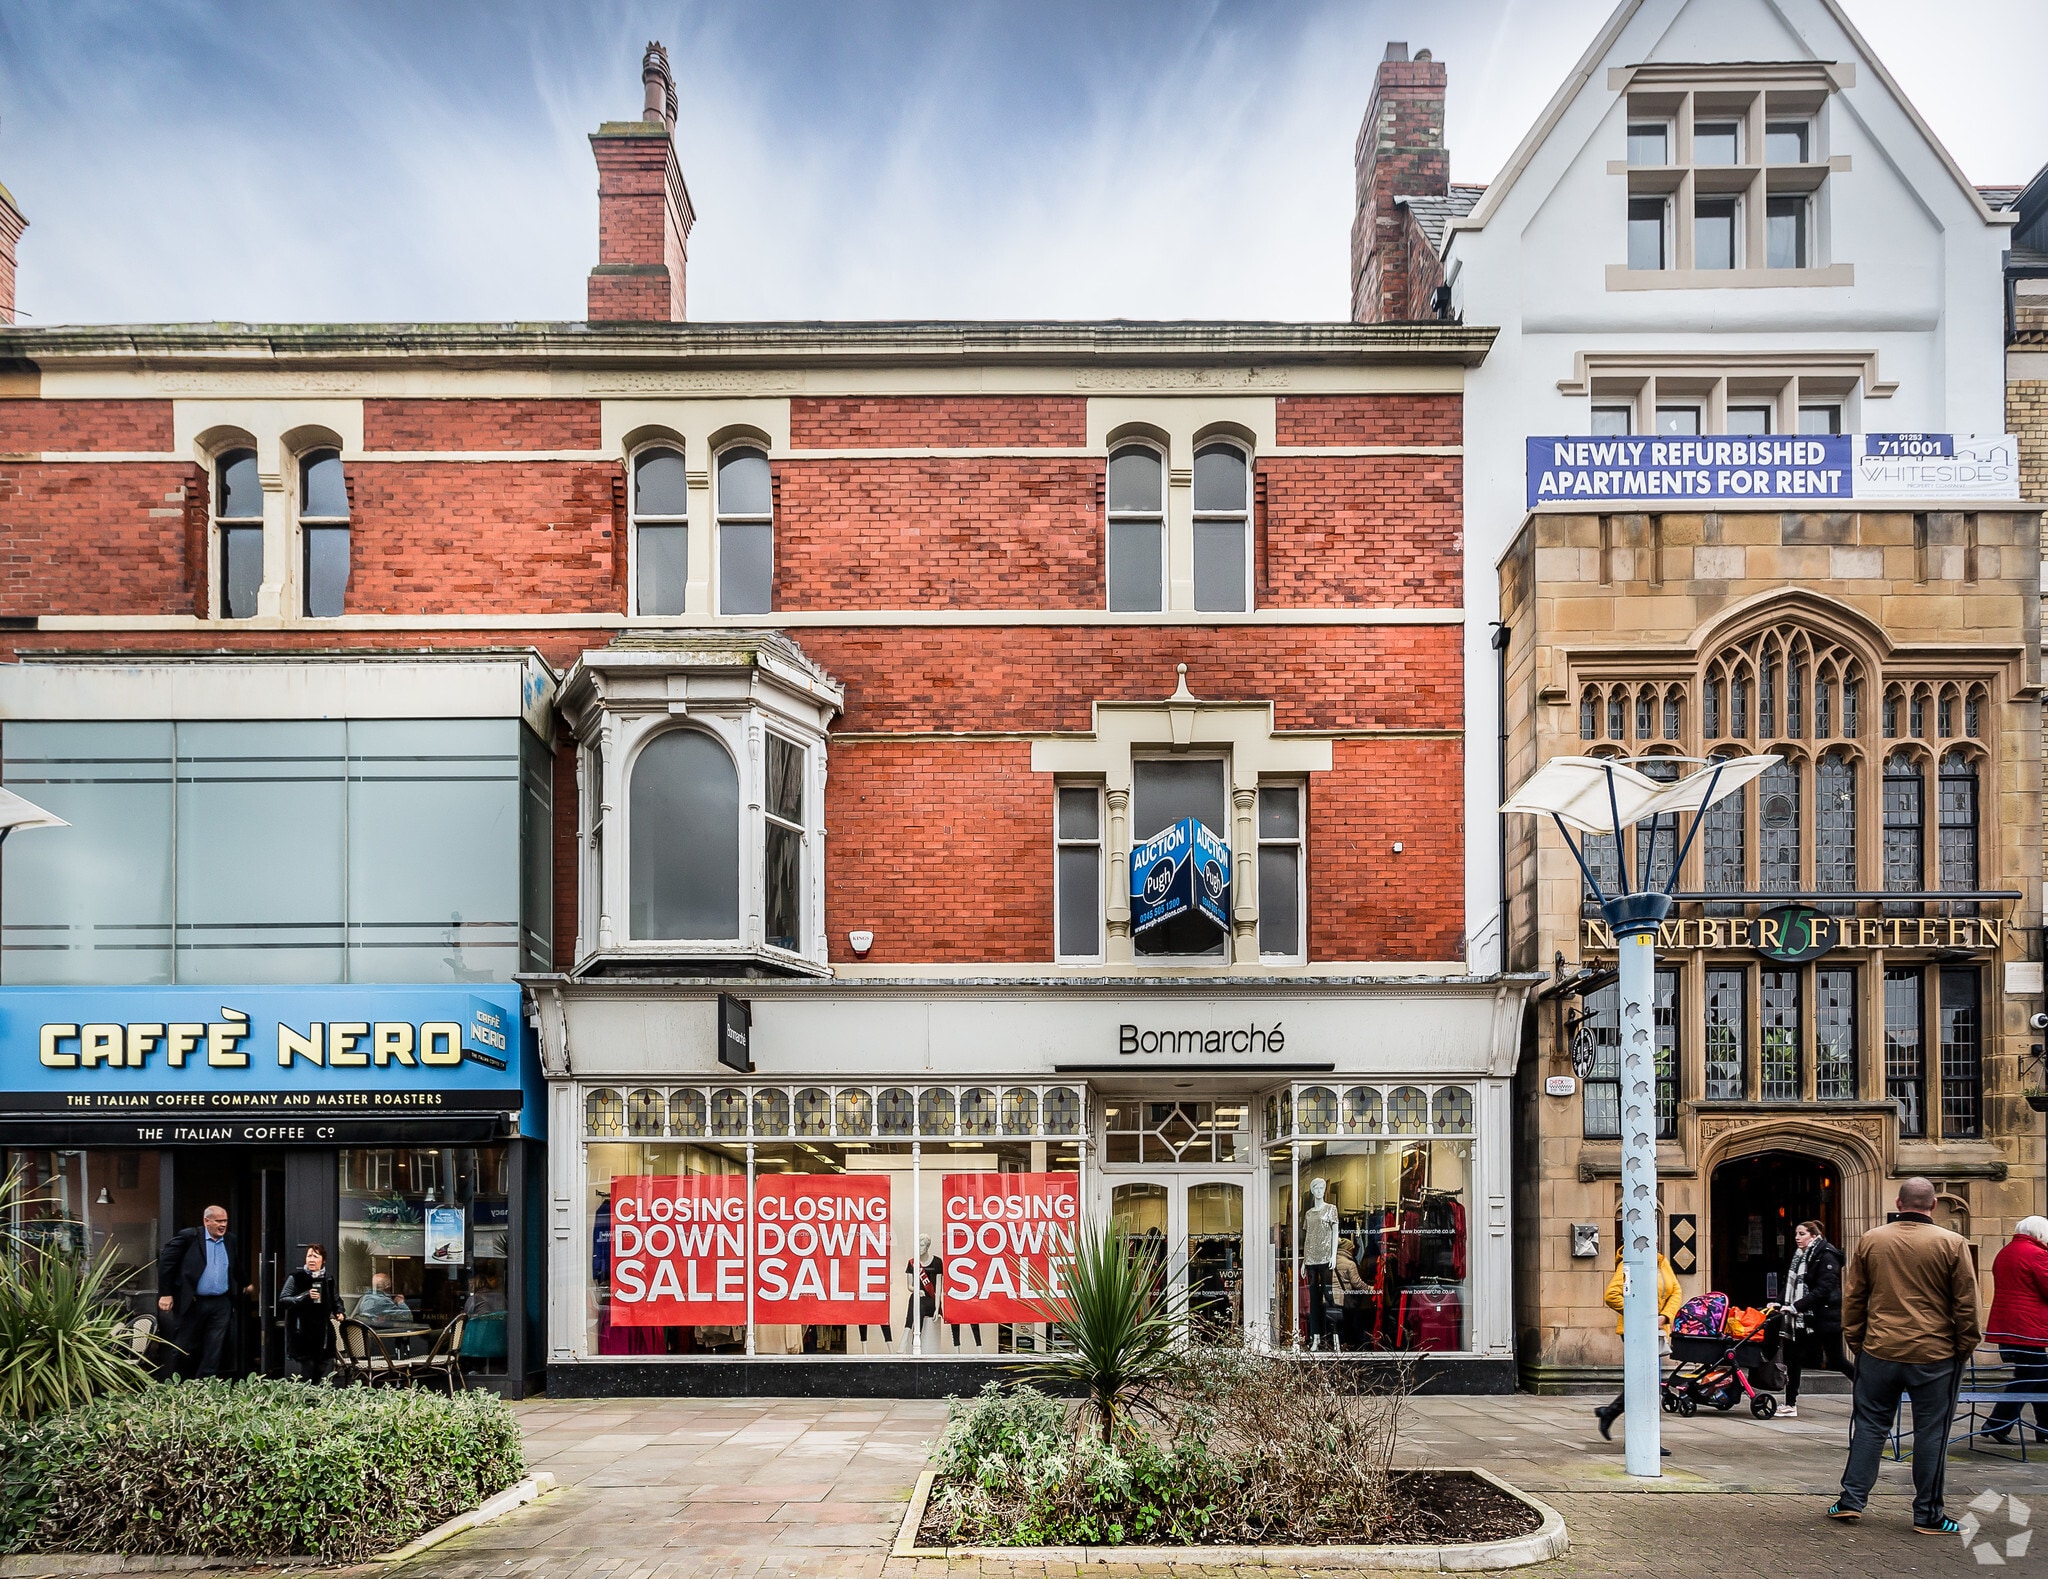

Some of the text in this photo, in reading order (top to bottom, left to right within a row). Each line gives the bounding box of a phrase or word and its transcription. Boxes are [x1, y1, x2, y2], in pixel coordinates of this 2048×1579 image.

[1554, 441, 1826, 466] NEWLY REFURBISHED
[1878, 441, 1942, 455] 711001
[1537, 469, 1842, 495] APARTMENTS FOR RENT
[1859, 465, 2010, 482] WHITESIDES
[1134, 826, 1185, 872] AUCTION
[1197, 827, 1228, 868] AUCTION
[1147, 867, 1171, 894] Pugh
[1206, 865, 1221, 894] Pugh
[1134, 905, 1187, 933] www.pugh-auctions.com
[1140, 910, 1153, 923] 0345
[1154, 905, 1165, 917] 505
[1166, 897, 1180, 910] 1200
[1583, 918, 1783, 949] NMBER
[1771, 909, 1814, 956] 15
[1809, 917, 2004, 949] FIFTEEN
[477, 1010, 501, 1029] CAFFÈ
[39, 1006, 463, 1068] CAFFÈ NERO
[471, 1021, 506, 1051] NERO
[727, 1023, 747, 1047] Bonmarché
[1119, 1021, 1285, 1055] Bonmarché
[67, 1094, 442, 1106] THE ITALIAN COFFEE COMPANY AND MASTER ROASTERS
[137, 1128, 164, 1140] THE
[174, 1128, 232, 1139] ITALIAN
[243, 1127, 305, 1139] COFFEE
[615, 1197, 744, 1223] CLOSING
[757, 1196, 888, 1222] CLOSING
[946, 1194, 1075, 1220] CLOSING
[615, 1223, 745, 1258] DOWN
[757, 1222, 888, 1257] DOWN
[946, 1221, 1076, 1255] DOWN
[614, 1259, 745, 1303] SALE
[757, 1257, 888, 1302] SALE
[946, 1256, 1076, 1300] SALE
[1400, 1288, 1456, 1296] www.bonmarche.co.uk
